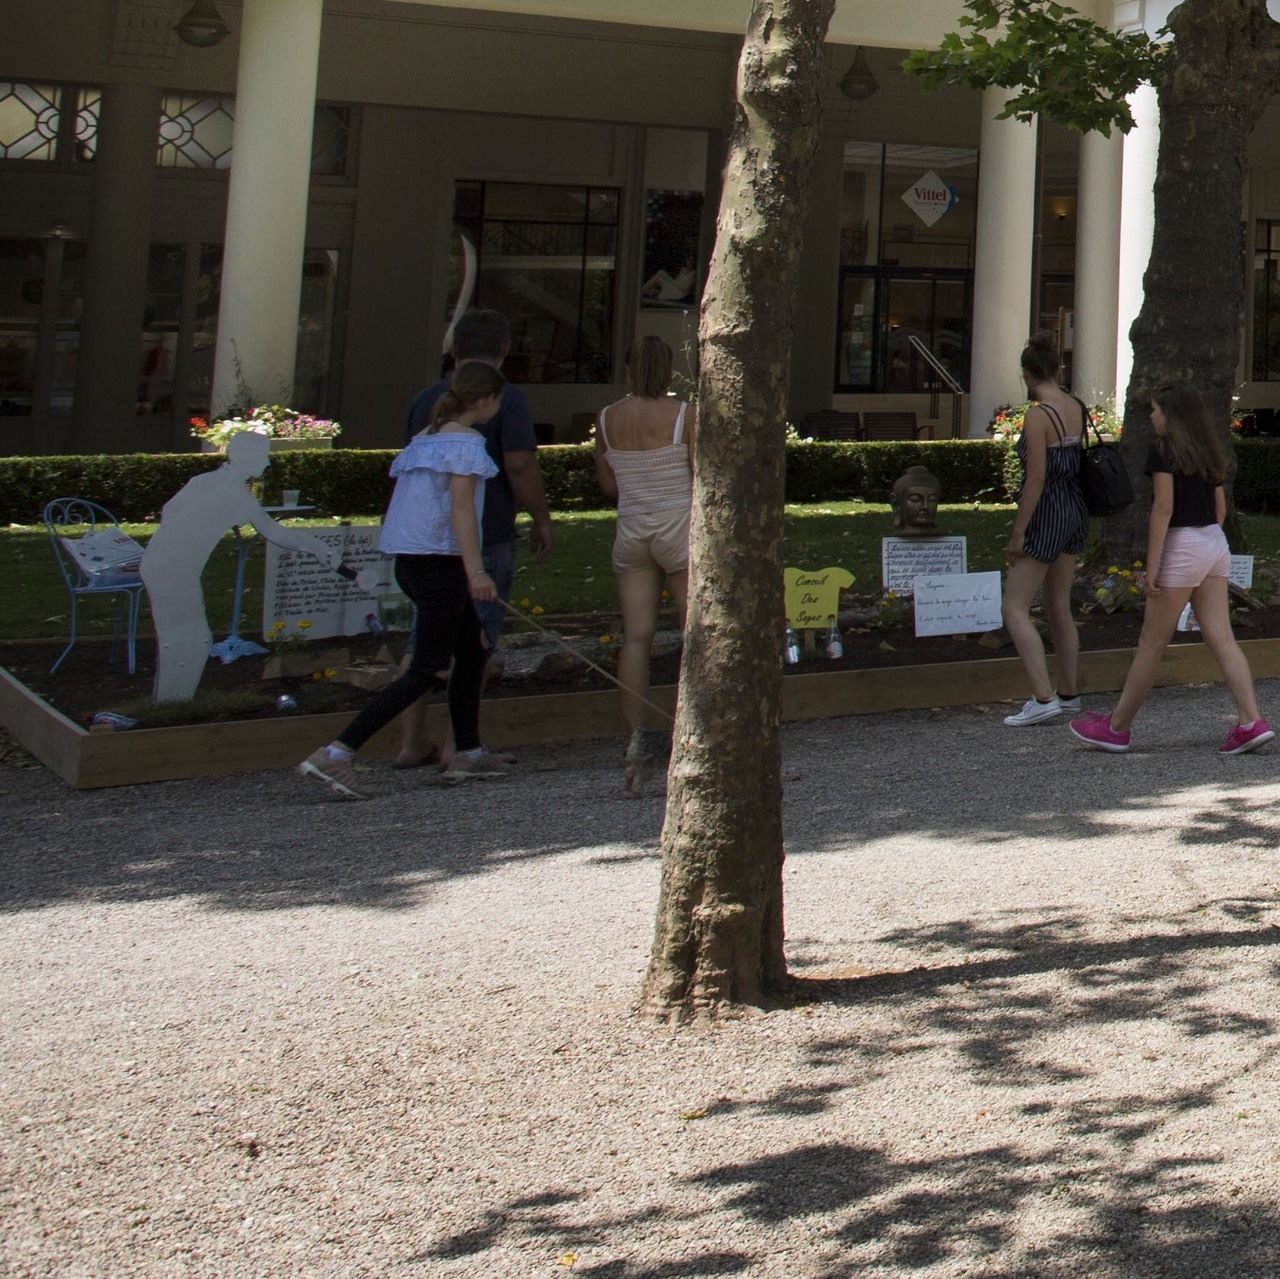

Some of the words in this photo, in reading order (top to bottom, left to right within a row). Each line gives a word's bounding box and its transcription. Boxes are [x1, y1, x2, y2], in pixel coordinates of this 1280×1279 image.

[914, 187, 946, 201] Vittel
[795, 575, 829, 587] Conseil
[801, 593, 818, 605] Des
[796, 611, 823, 625] Sages
